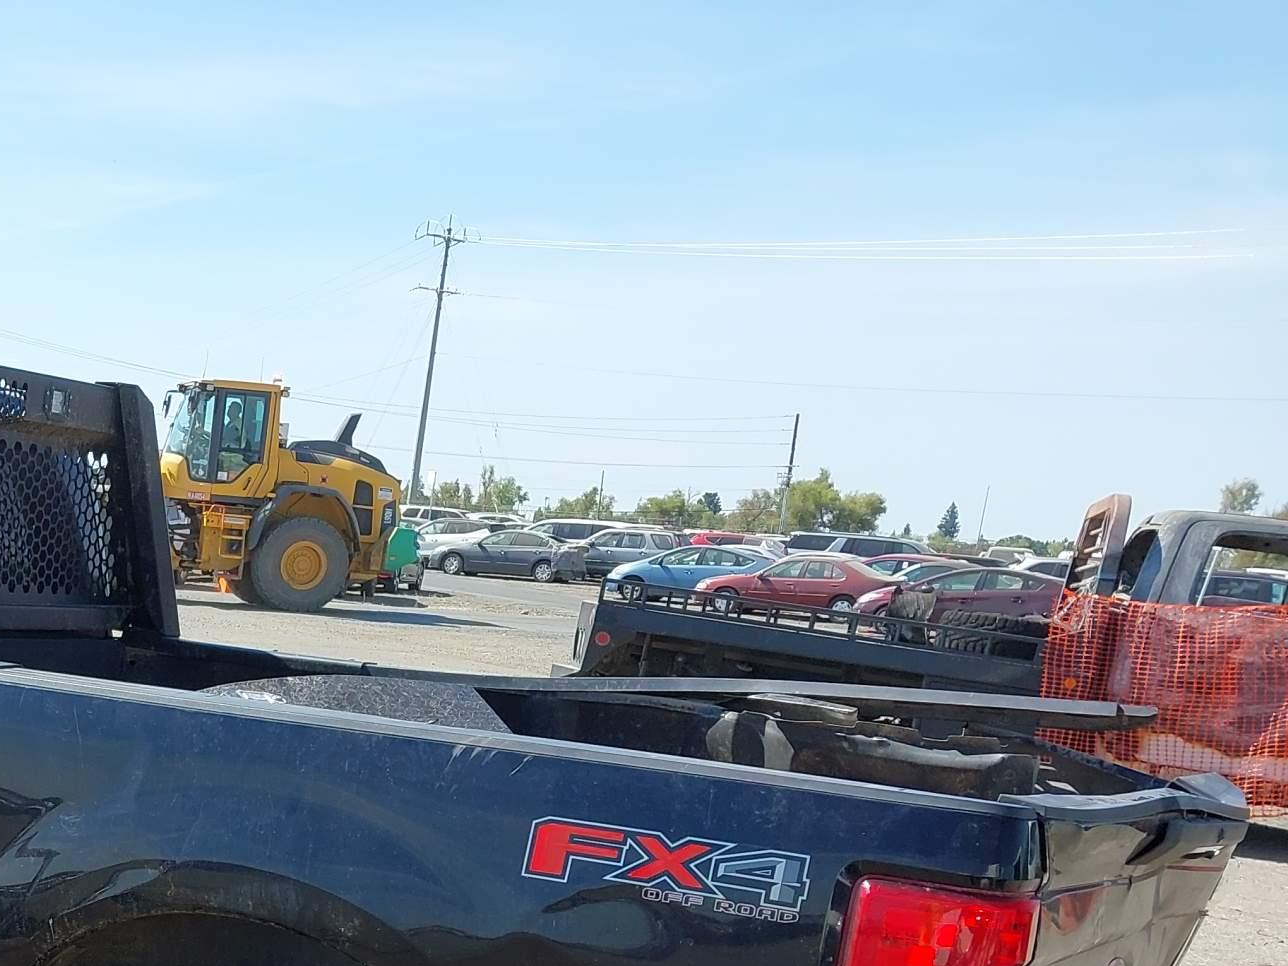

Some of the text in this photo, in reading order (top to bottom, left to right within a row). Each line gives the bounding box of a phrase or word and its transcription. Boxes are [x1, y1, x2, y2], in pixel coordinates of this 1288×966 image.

[521, 816, 810, 910] FX4
[641, 887, 799, 923] OFF ROAD
